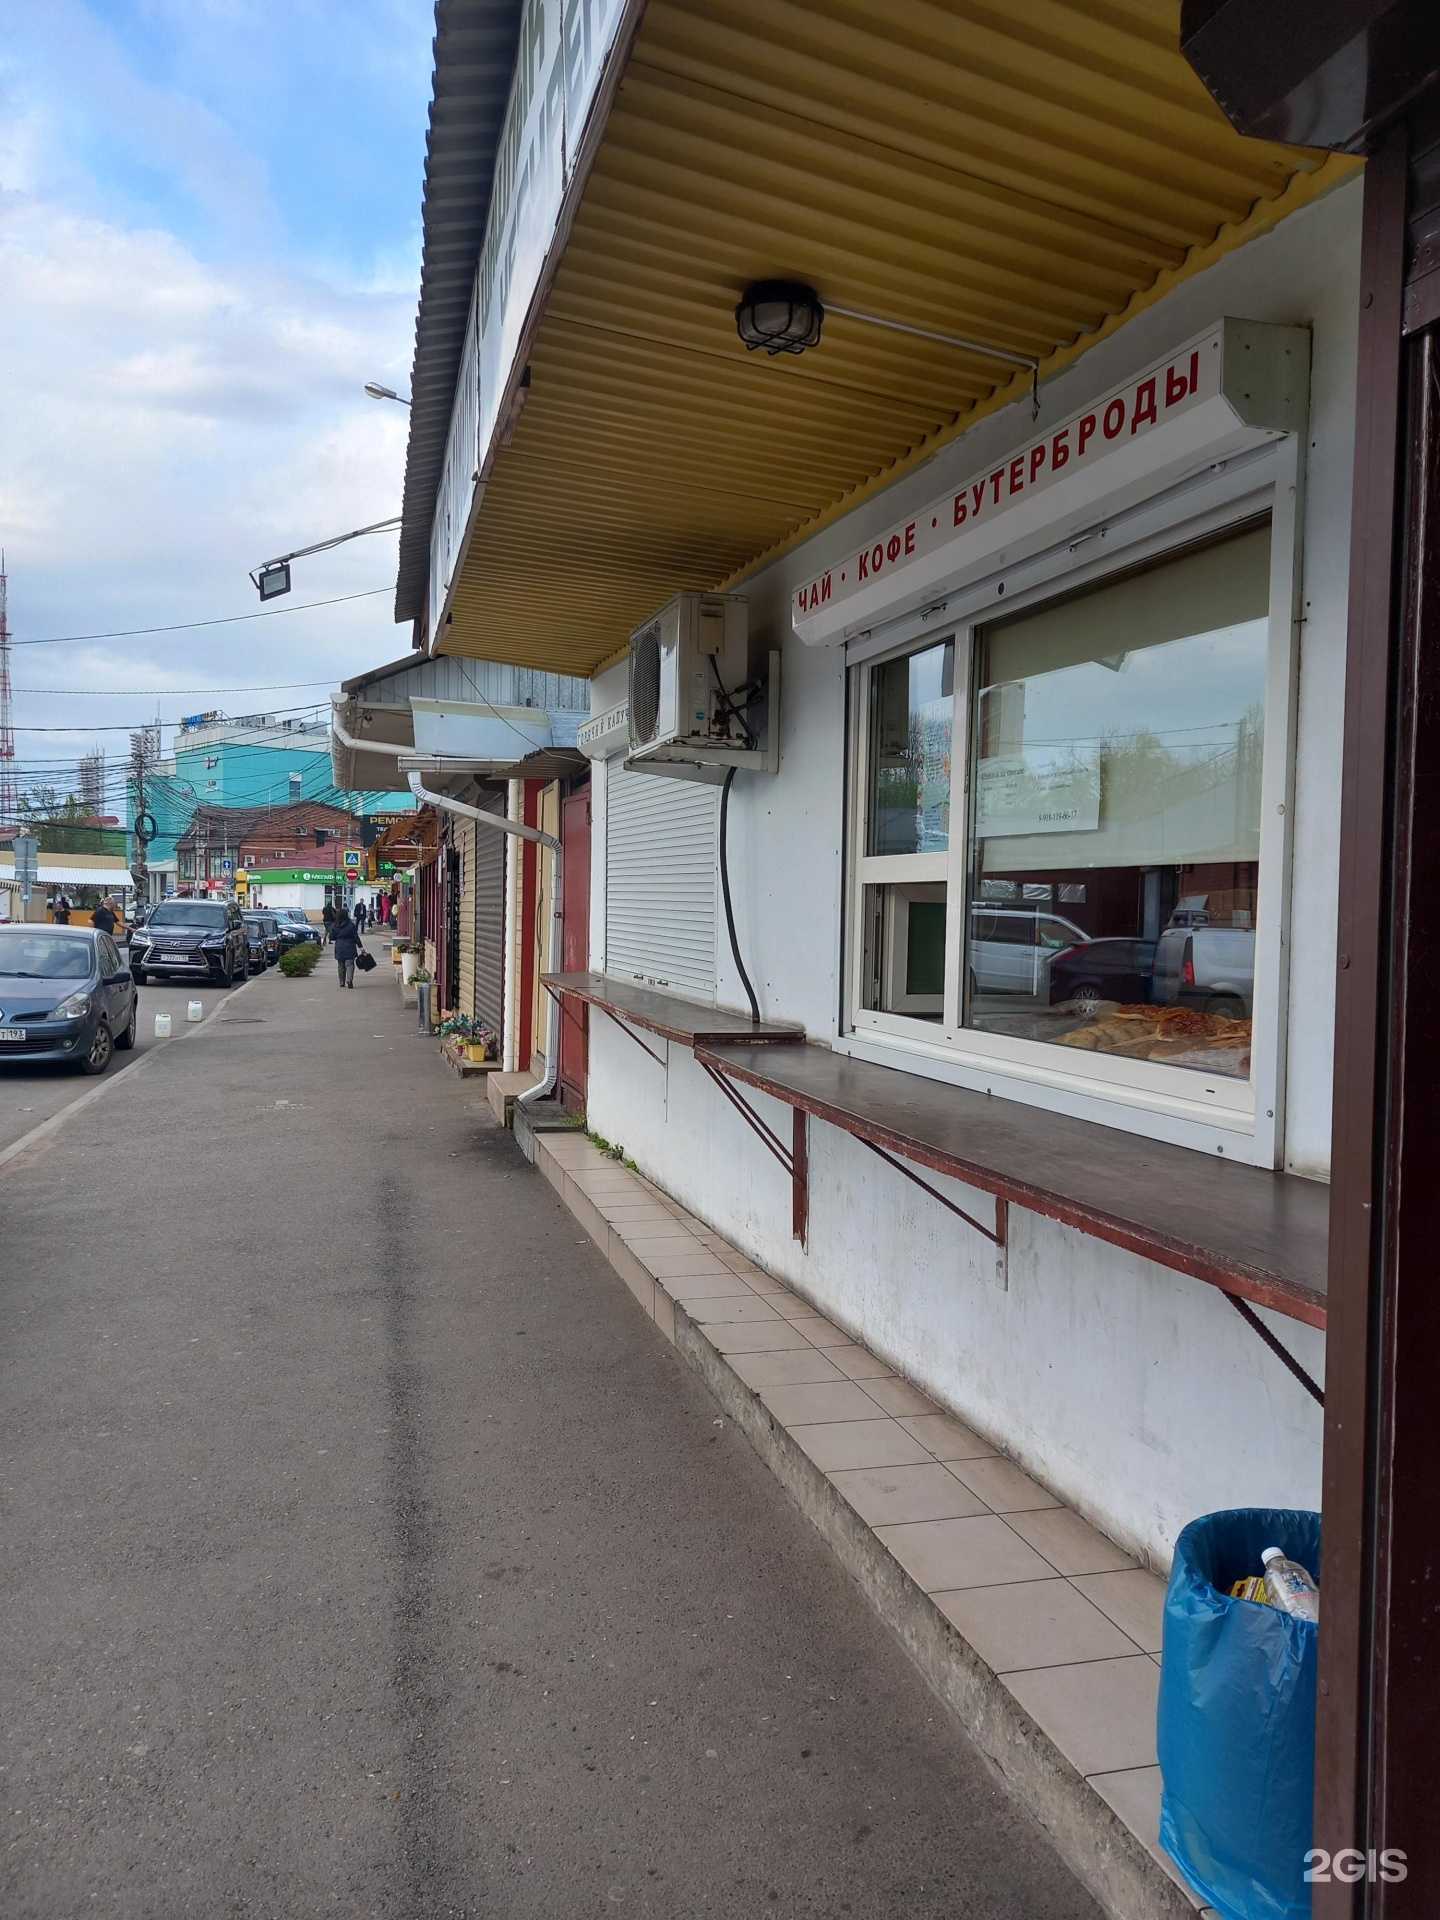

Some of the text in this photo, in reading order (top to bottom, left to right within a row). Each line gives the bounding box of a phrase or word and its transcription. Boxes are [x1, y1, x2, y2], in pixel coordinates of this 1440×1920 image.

[797, 351, 1200, 612] ЧАЙ КОФЕ БУТЕРБРОДЫ
[369, 816, 407, 825] РЕМО
